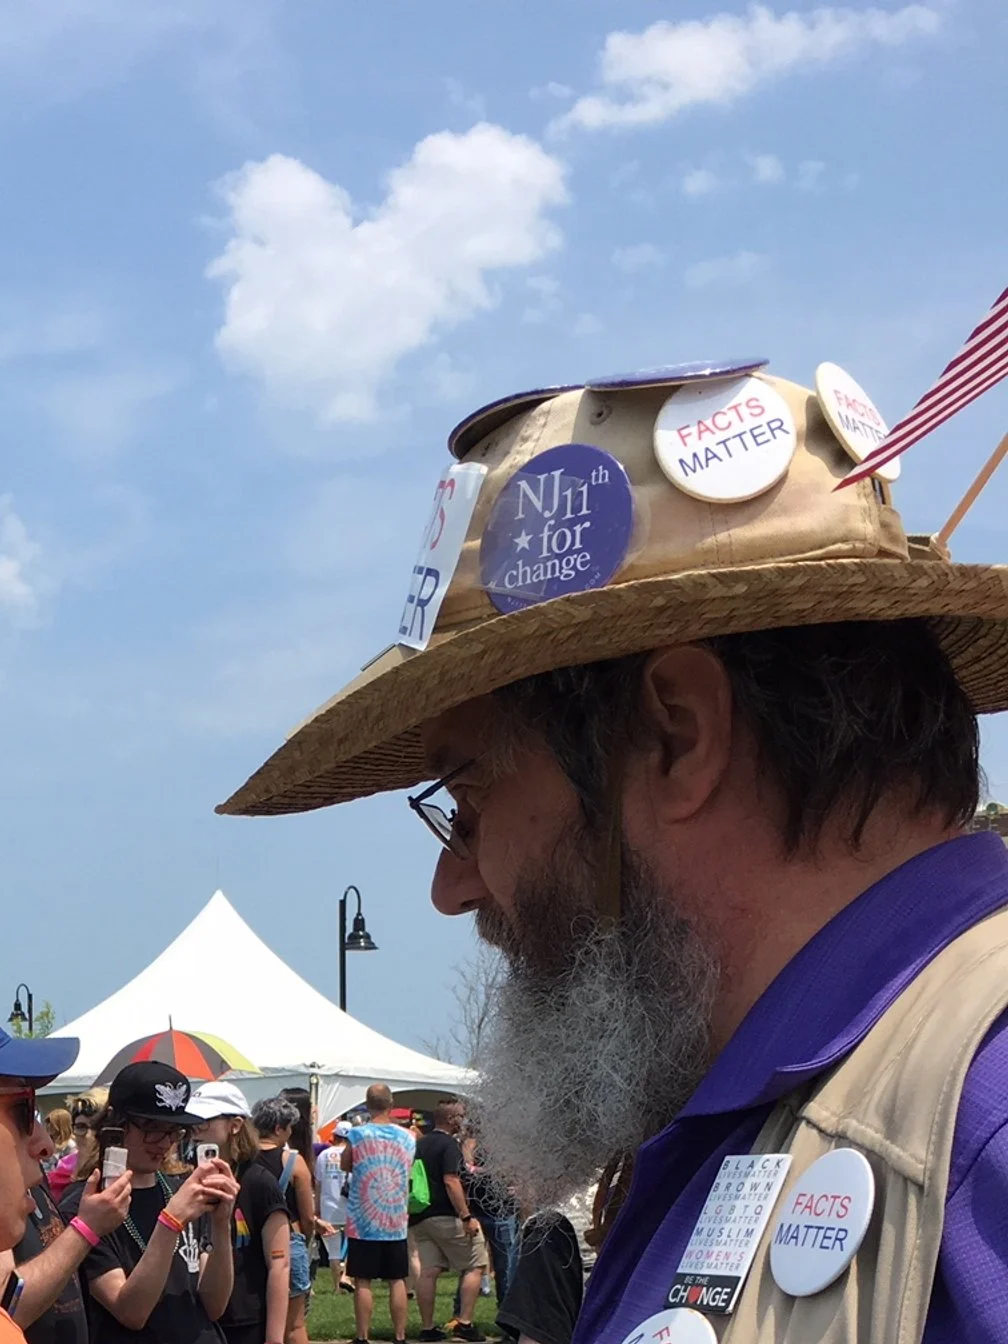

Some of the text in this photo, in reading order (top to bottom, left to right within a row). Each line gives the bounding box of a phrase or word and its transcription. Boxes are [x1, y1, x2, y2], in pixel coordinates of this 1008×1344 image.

[833, 389, 881, 426] FACTS
[676, 397, 765, 447] FACTS
[678, 417, 790, 478] MATTER
[538, 519, 591, 559] for
[504, 551, 591, 590] change
[722, 1158, 784, 1171] BLACK
[712, 1182, 774, 1194] BROWN
[703, 1204, 764, 1216] LGBTQ
[791, 1193, 852, 1219] FACTS
[695, 1227, 755, 1239] MUSLIM
[774, 1222, 849, 1252] MATTER
[695, 1276, 710, 1285] THE
